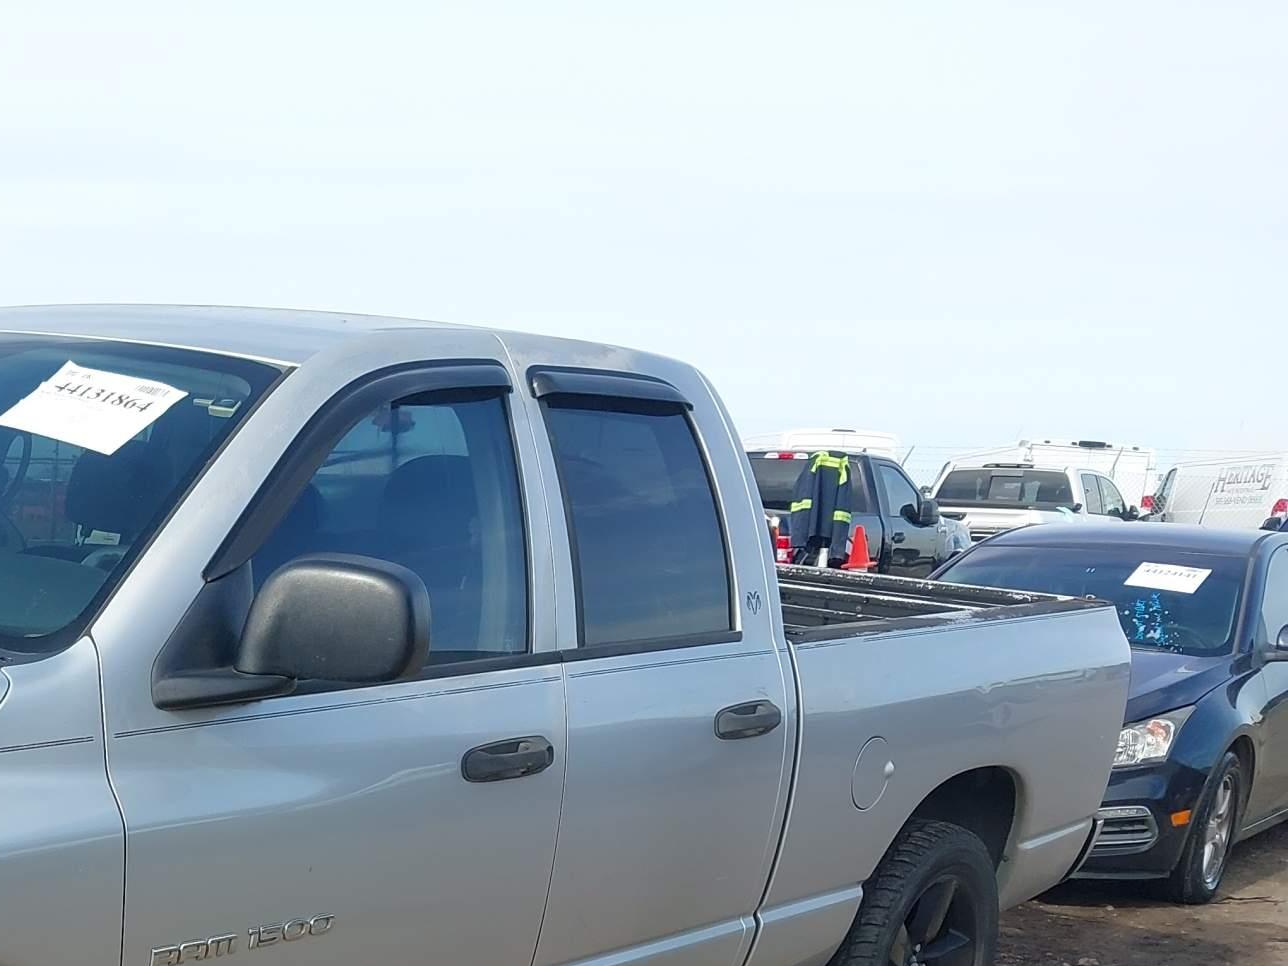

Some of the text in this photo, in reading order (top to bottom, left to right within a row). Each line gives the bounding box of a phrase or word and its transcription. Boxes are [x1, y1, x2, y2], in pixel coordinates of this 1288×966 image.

[55, 381, 154, 413] 44131864
[1213, 464, 1275, 493] HERITAGE
[247, 913, 335, 951] 1500
